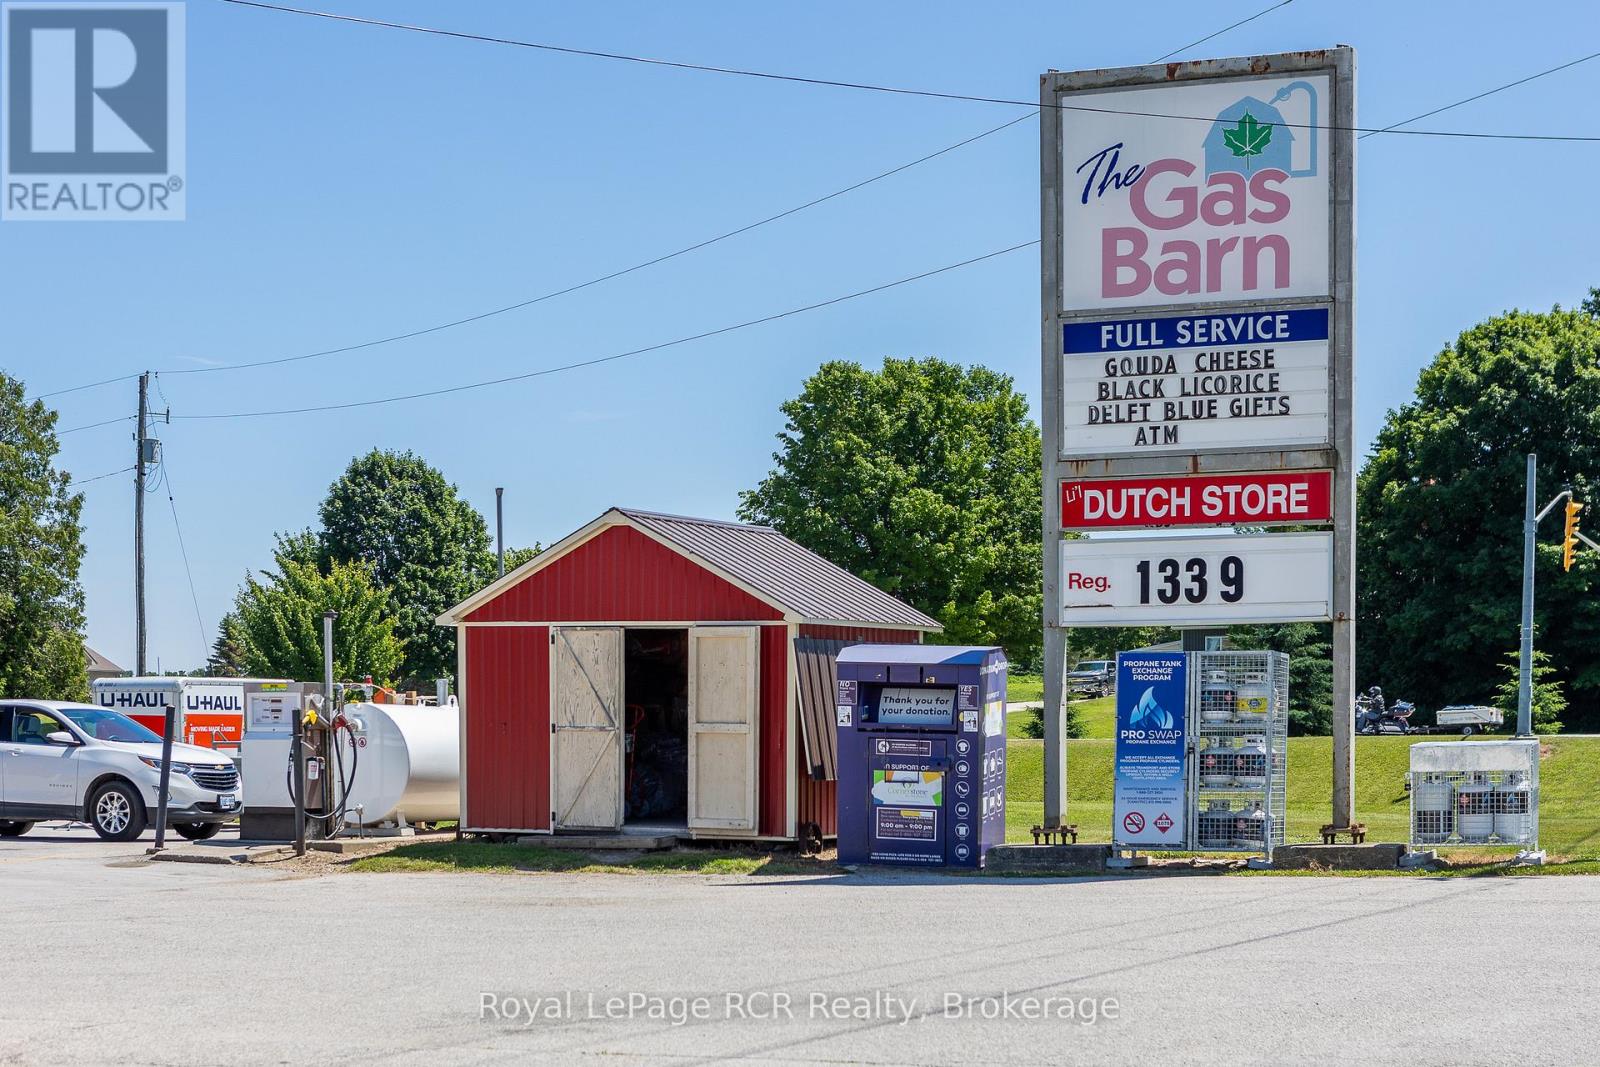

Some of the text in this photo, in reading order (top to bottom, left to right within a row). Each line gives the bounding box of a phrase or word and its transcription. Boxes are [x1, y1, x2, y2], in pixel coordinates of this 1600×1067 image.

[1076, 142, 1291, 231] The Gas
[1101, 226, 1290, 298] Barn
[1101, 315, 1290, 349] FULL SERVICE
[1105, 349, 1275, 377] GOUDA CHEESE
[1097, 372, 1280, 401] BLACK LICORICE
[1088, 396, 1290, 424] DELFT BLUE GIFTS
[1135, 424, 1179, 446] ATM
[1083, 486, 1191, 520] DUTCH
[1201, 483, 1309, 517] STORE
[1068, 572, 1112, 593] Reg.
[840, 680, 850, 688] NO
[101, 692, 169, 707] U-HAUL
[187, 695, 242, 710] U-HAUL
[883, 696, 950, 706] Thank you for
[905, 707, 951, 716] donation.
[1121, 730, 1182, 739] PRO SWAP
